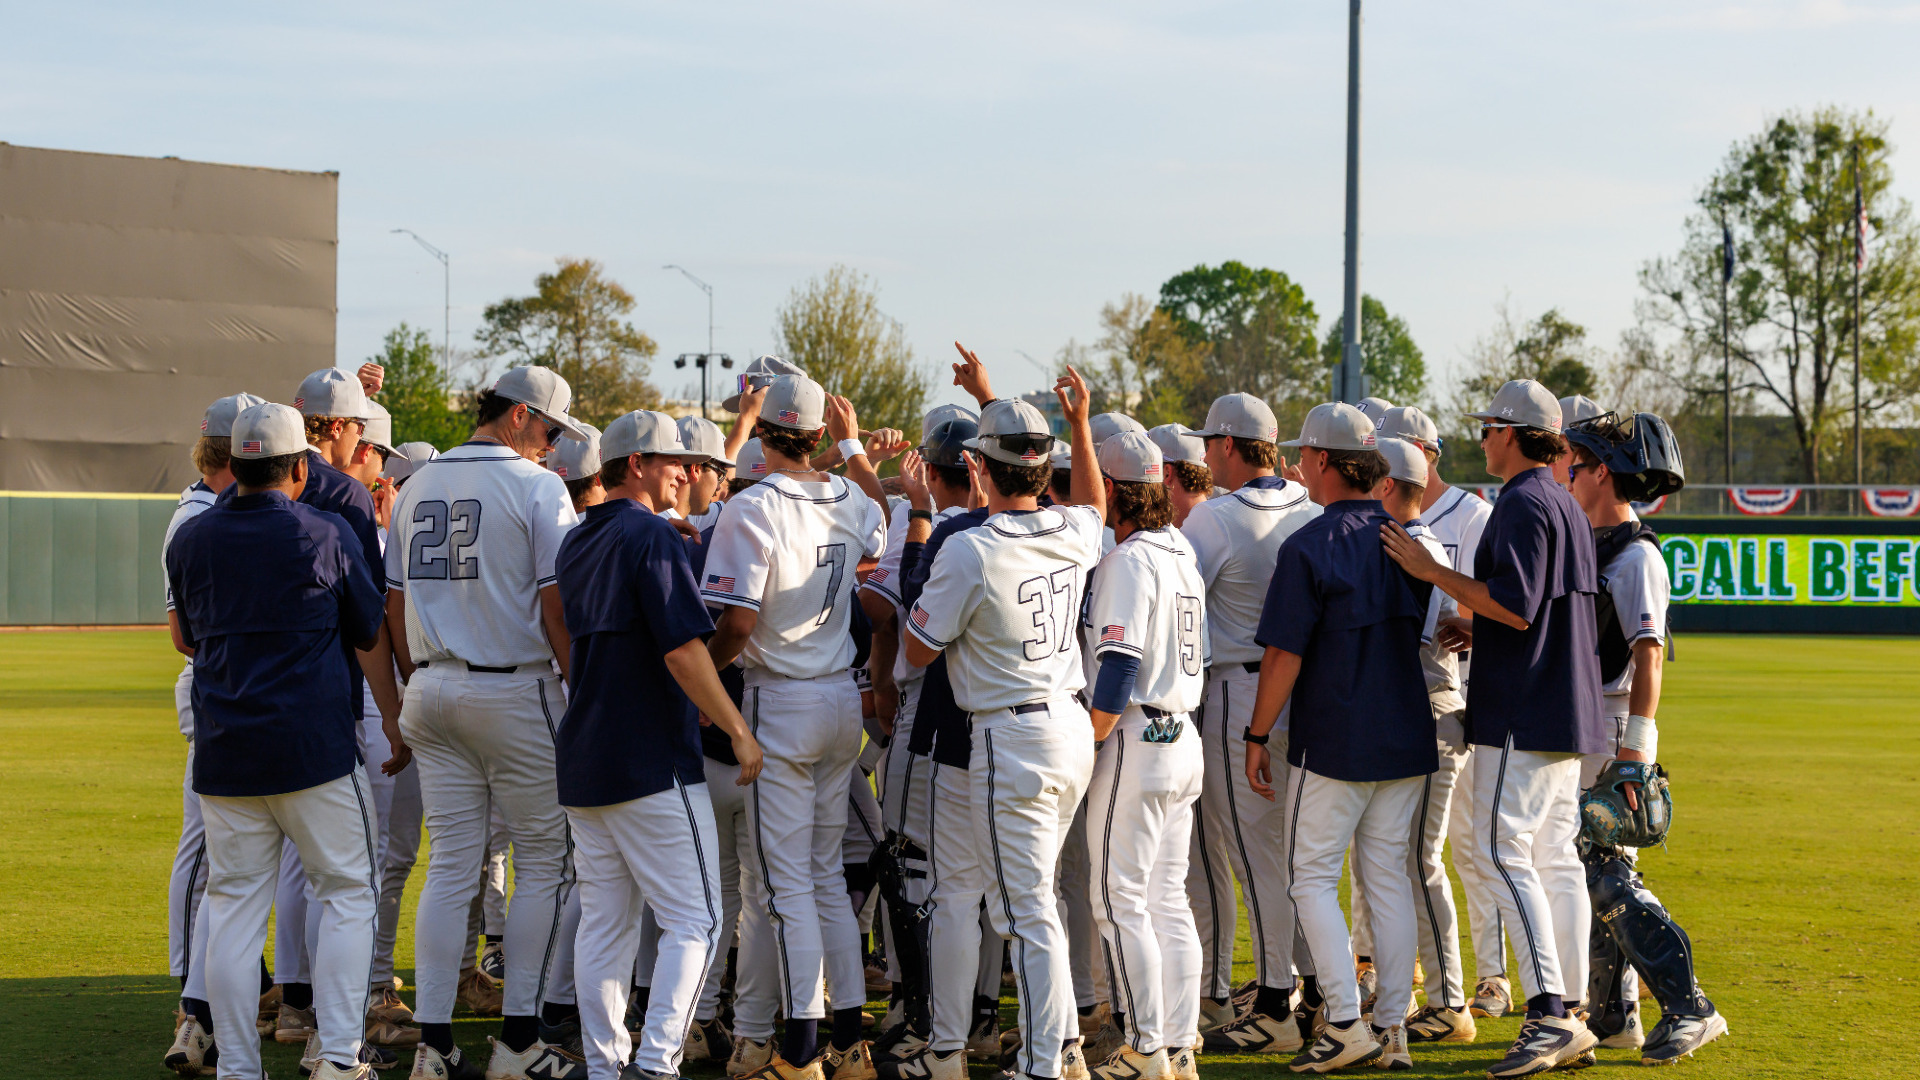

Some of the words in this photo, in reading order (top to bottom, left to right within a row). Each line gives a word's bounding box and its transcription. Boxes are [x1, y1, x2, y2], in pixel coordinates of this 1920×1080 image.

[408, 499, 482, 580] 22
[1660, 537, 1796, 601] CALL
[1808, 538, 1920, 602] BEF
[815, 542, 846, 626] 7
[1018, 564, 1077, 662] 37
[531, 1053, 576, 1079] N
